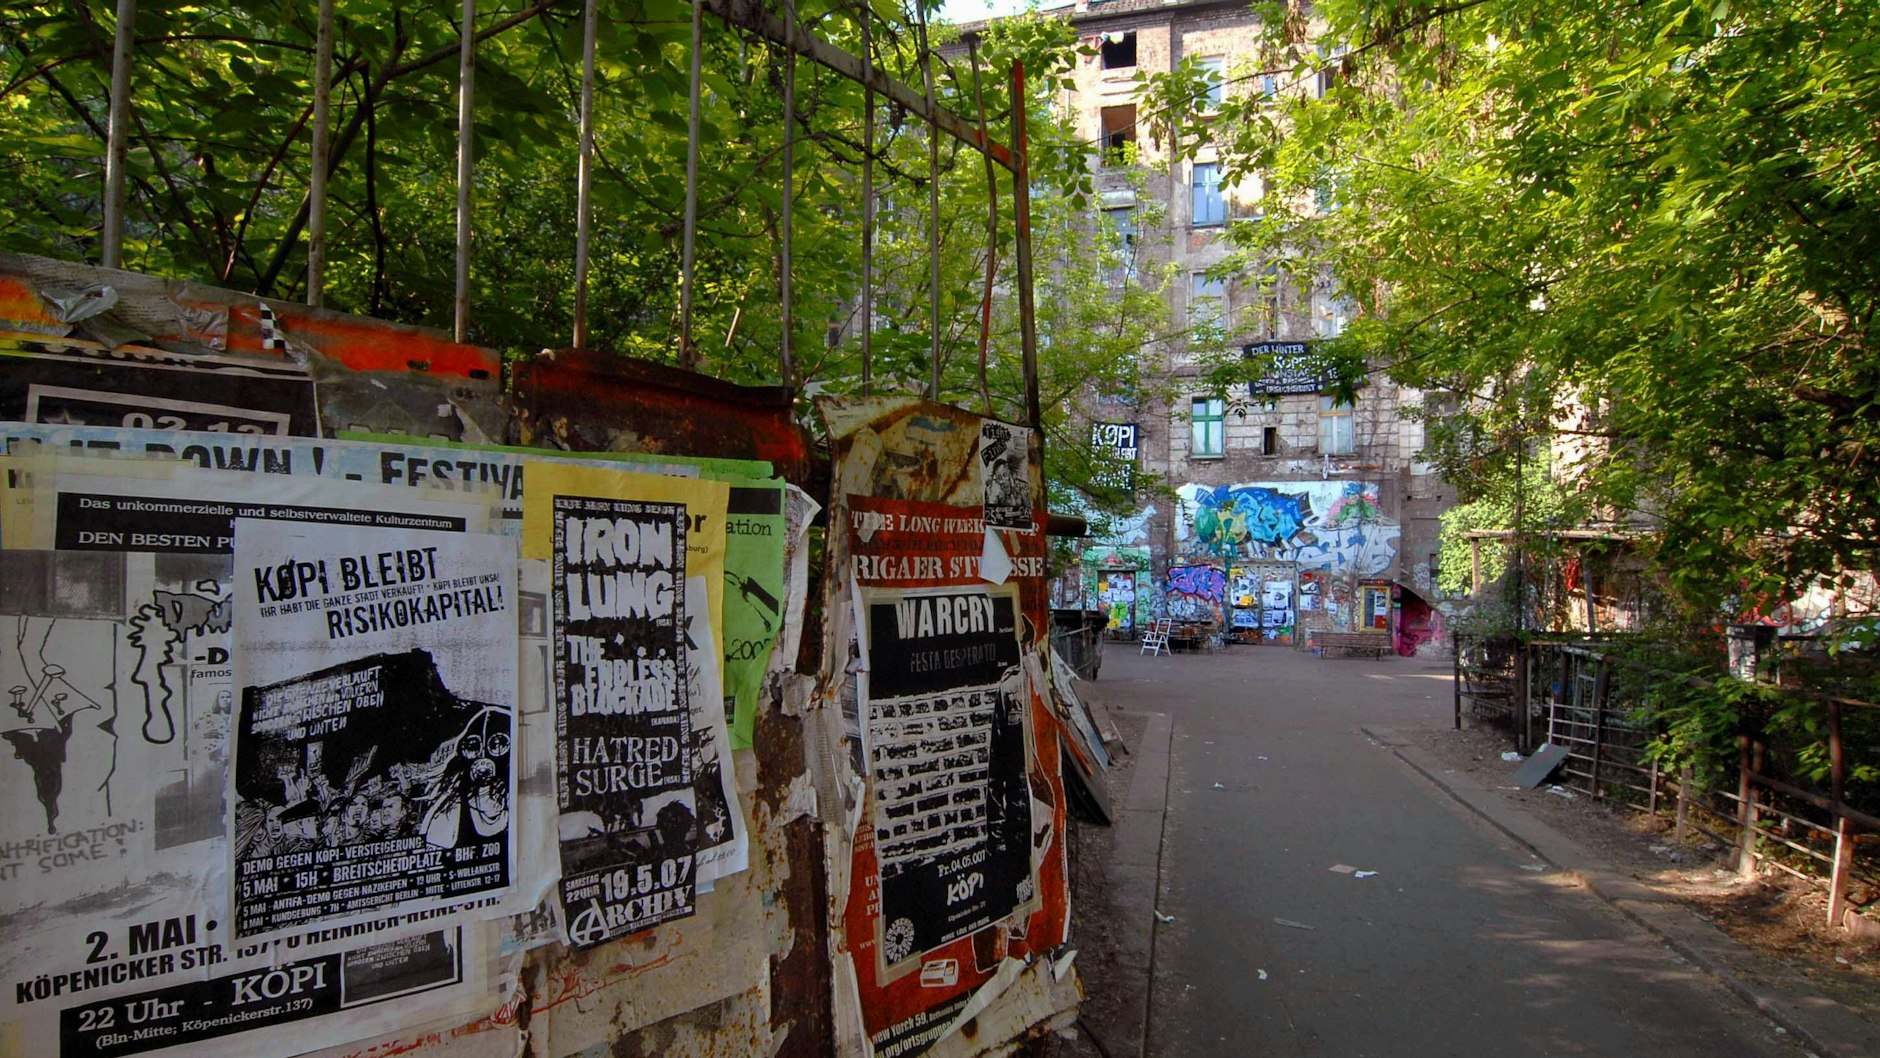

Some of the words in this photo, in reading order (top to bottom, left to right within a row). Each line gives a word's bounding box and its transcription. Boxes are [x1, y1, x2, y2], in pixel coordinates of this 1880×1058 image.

[79, 497, 111, 509] Das
[117, 500, 234, 516] unkommerzielle
[238, 506, 266, 517] und
[269, 507, 372, 523] selbstverwaltete
[375, 515, 453, 529] Kulturzentrum
[899, 514, 941, 533] LONG
[944, 517, 1007, 534] WEEK
[78, 531, 123, 545] DEN
[131, 532, 211, 548] BESTEN
[565, 516, 673, 568] IRON
[340, 547, 438, 592] BLEIBT
[851, 554, 944, 580] RIGAER
[950, 556, 1044, 578] STSSE
[260, 606, 278, 618] IHR
[280, 601, 304, 615] HABT
[305, 599, 321, 612] DIE
[323, 595, 353, 609] GANZE
[354, 591, 380, 604] STADT
[381, 583, 425, 600] VERKAUFT!
[452, 575, 478, 589] BLEIBT
[327, 585, 506, 640] RISIKOKAPITAL!
[566, 569, 675, 622] LUNG
[895, 595, 995, 640] WARCRY
[566, 634, 606, 665] THE
[356, 690, 384, 708] OBEN
[287, 726, 306, 741] UND
[309, 716, 348, 736] UNTEN
[572, 736, 679, 764] HATRED
[576, 761, 664, 796] SURGE
[242, 858, 273, 875] DEMO
[276, 852, 312, 869] GEGEN
[295, 871, 318, 889] 15H
[333, 851, 443, 883] BREITSCHEIDPLATZ
[481, 842, 501, 858] ZOO
[565, 872, 600, 891] SAMSTAG
[601, 855, 693, 902] 19.5.07
[249, 917, 263, 929] MAI
[271, 906, 321, 923] KUNDGEBUNG
[347, 891, 394, 910] AMTSGERICHT
[395, 890, 419, 902] BERLIN
[425, 885, 445, 896] MITTE
[250, 903, 267, 915] MAI
[273, 891, 331, 911] ANTIFA-DEMO
[332, 887, 360, 901] GEGEN
[426, 873, 441, 884] UHR
[86, 931, 118, 964] 2.
[128, 914, 196, 957] MAI
[16, 958, 175, 1004] KÖPENICKER
[181, 944, 228, 969] STR.
[78, 1007, 115, 1032] 22
[126, 998, 184, 1024] Uhr
[231, 961, 327, 1006] KÖPI
[96, 1026, 178, 1049] (Bln-Mitte;
[182, 998, 313, 1032] Köpenickerstr.137)
[891, 1018, 915, 1035] Yorck
[916, 1011, 928, 1028] 59,
